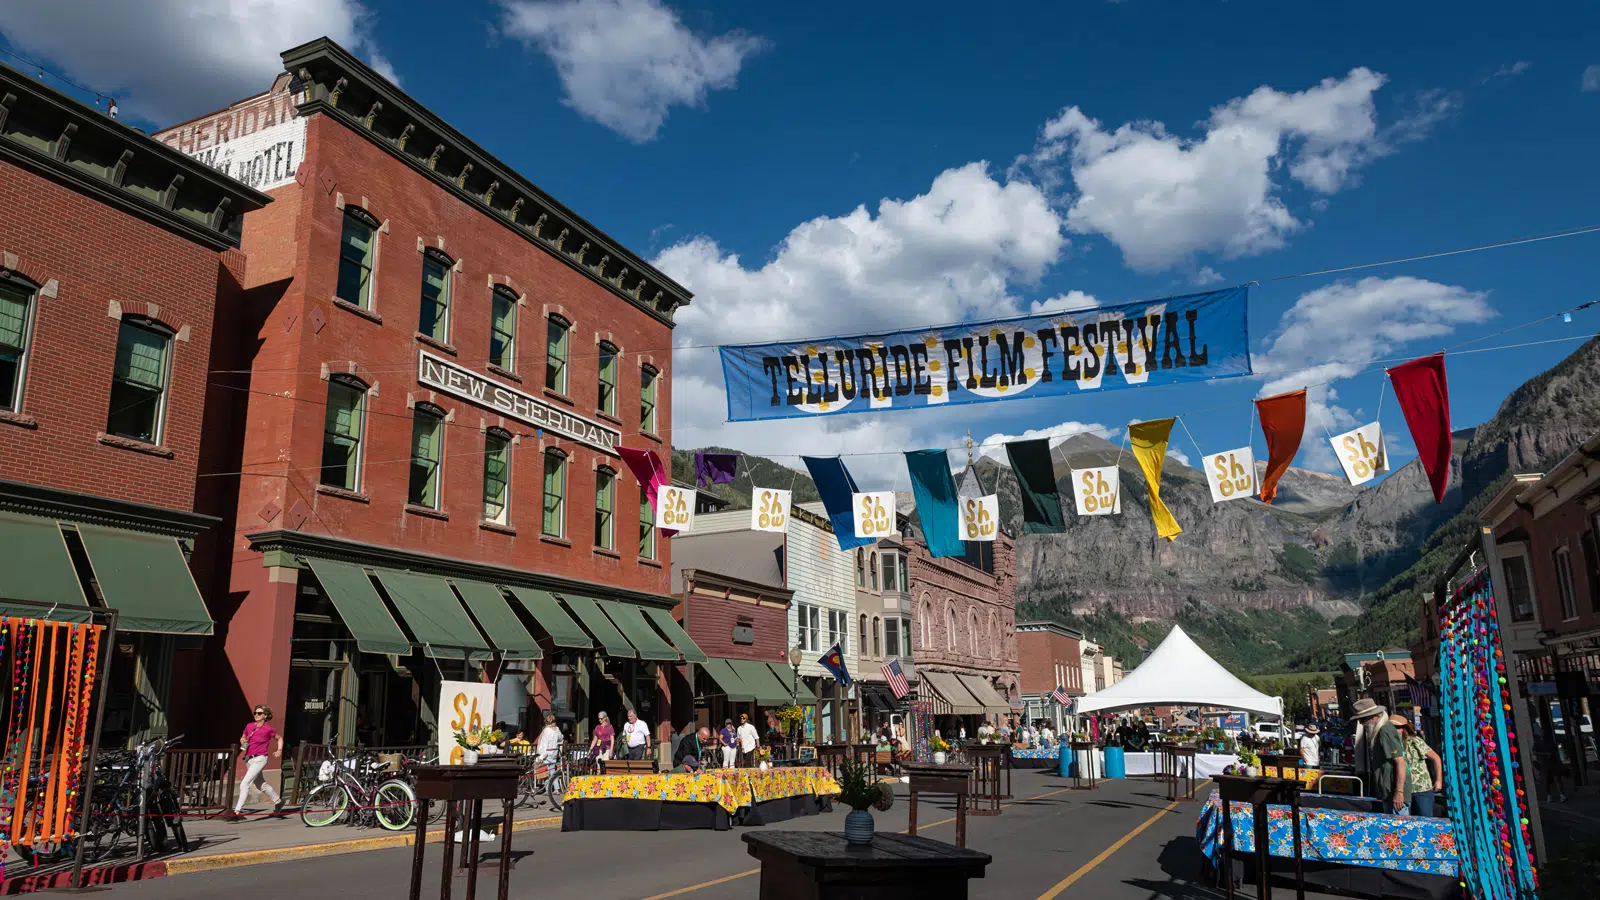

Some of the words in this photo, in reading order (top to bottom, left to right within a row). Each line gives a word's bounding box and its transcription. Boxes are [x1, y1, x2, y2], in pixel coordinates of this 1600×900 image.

[239, 141, 296, 188] HOTEL
[762, 343, 931, 406] TELLURIDE
[944, 331, 1027, 391] FILM
[1037, 310, 1208, 382] FESTIVAL
[425, 359, 488, 400] NEW
[494, 388, 615, 450] SHERIDAN
